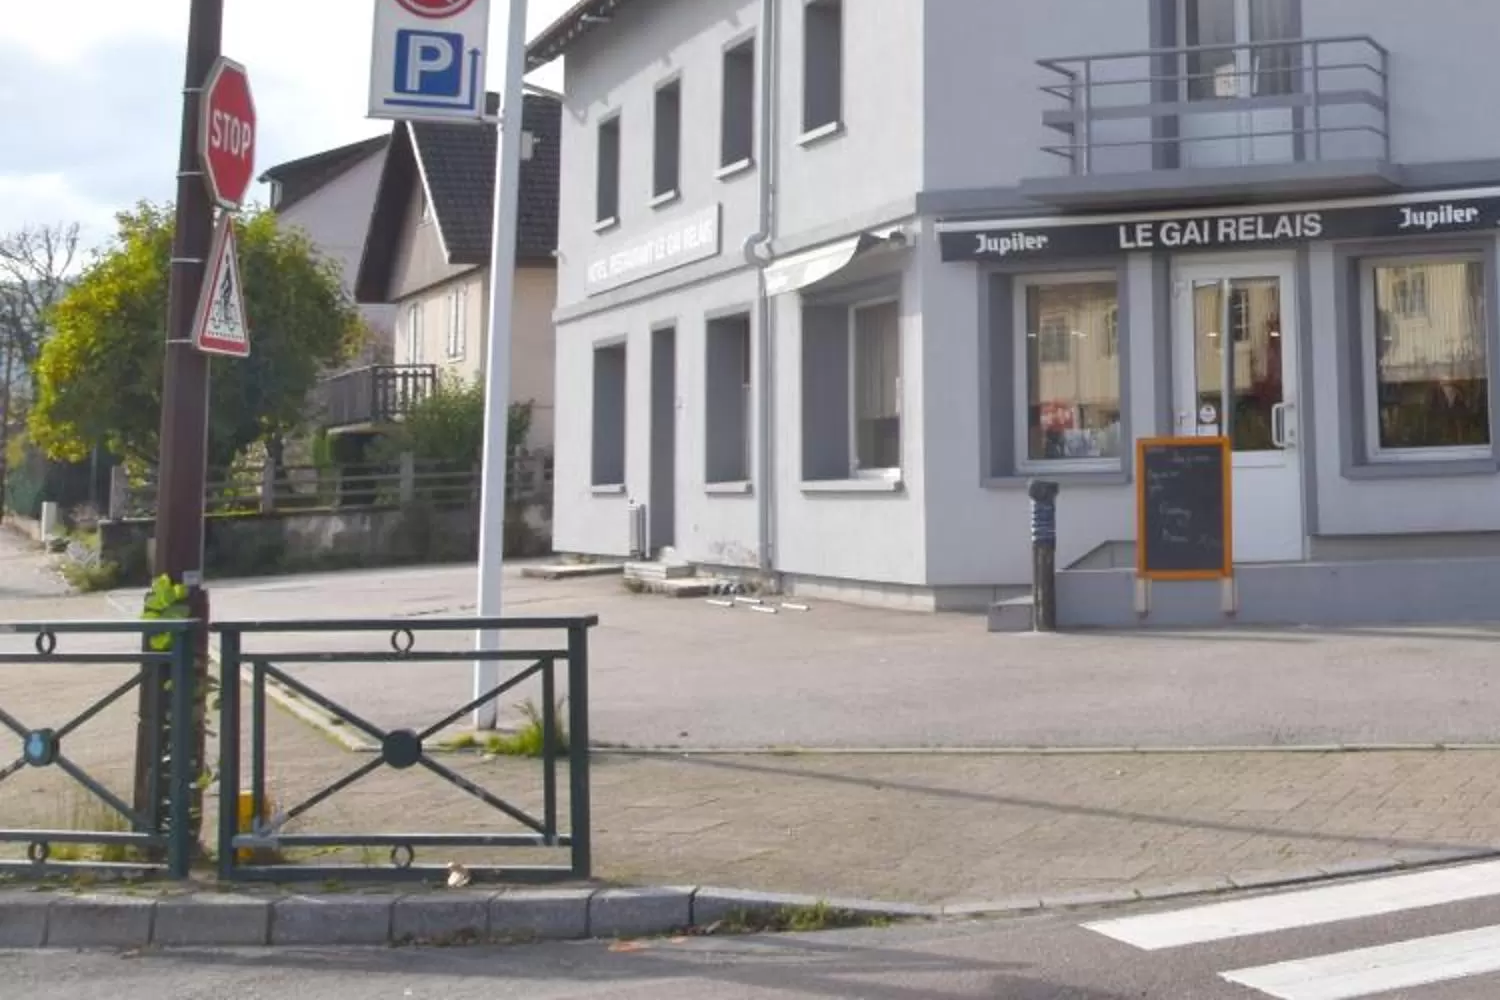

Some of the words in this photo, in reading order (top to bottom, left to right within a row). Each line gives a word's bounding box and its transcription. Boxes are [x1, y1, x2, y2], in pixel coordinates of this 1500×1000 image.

[406, 34, 453, 92] P
[211, 108, 252, 161] STOP
[1119, 223, 1153, 249] LE
[1159, 219, 1210, 246] GAI
[1217, 213, 1323, 242] RELAIS
